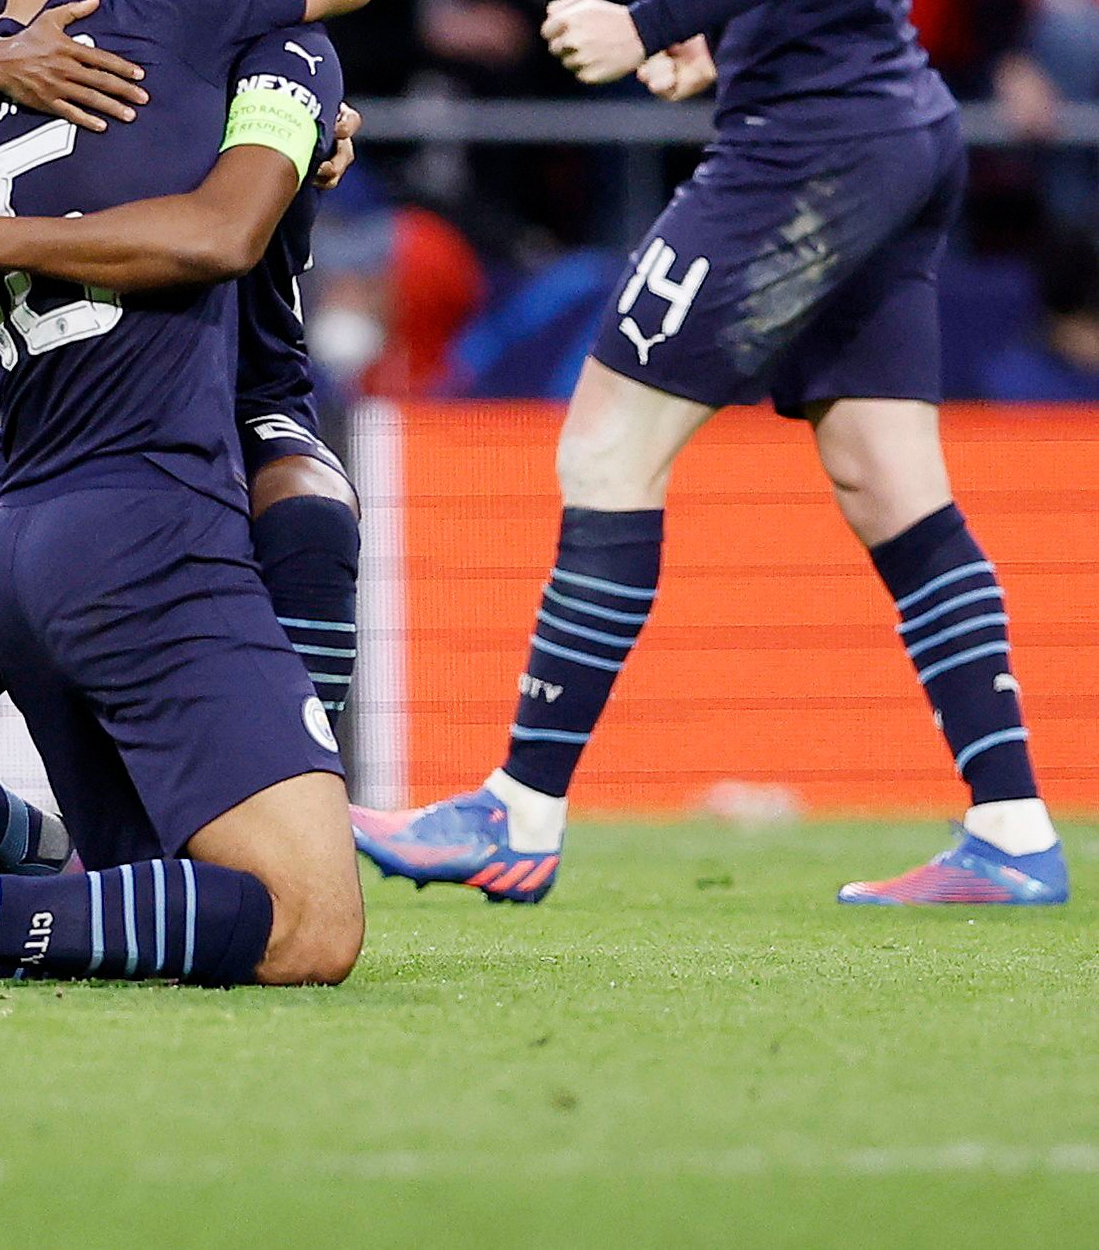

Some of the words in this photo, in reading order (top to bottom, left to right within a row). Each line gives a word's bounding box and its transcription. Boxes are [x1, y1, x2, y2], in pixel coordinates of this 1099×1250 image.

[236, 73, 322, 120] NEXEN
[617, 237, 710, 337] 14
[20, 911, 53, 965] CITY
